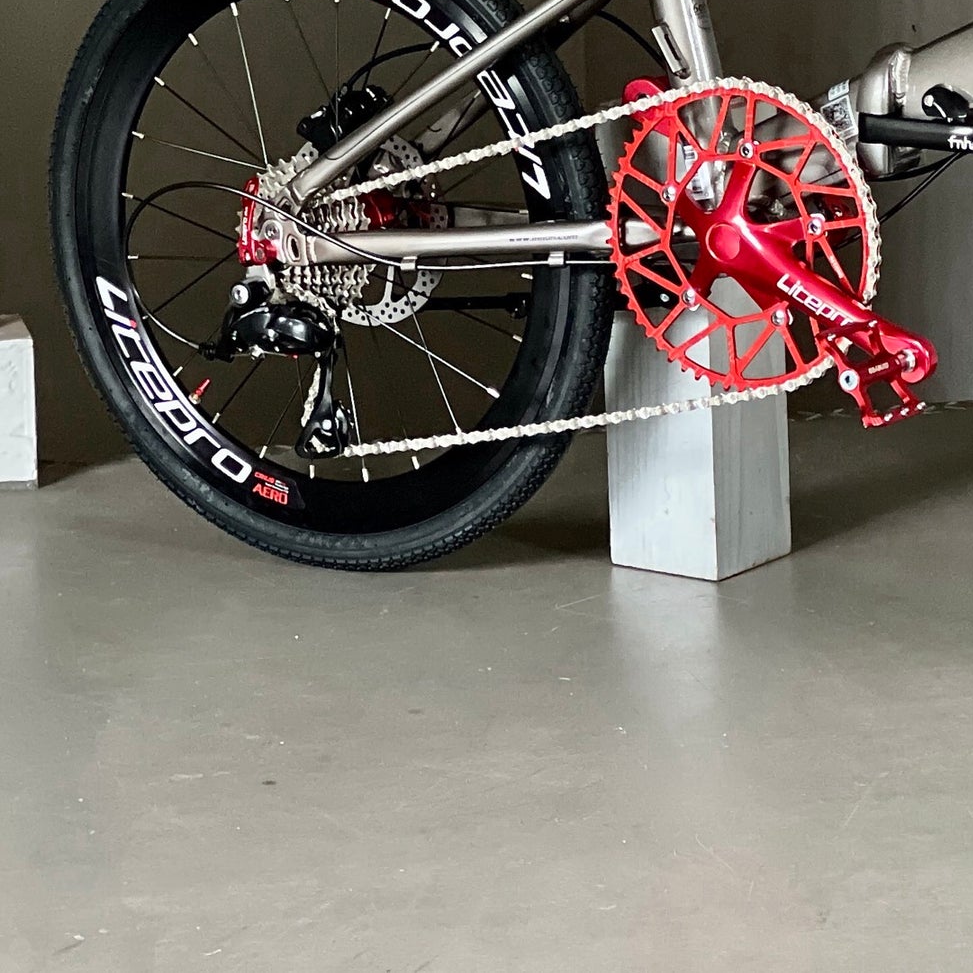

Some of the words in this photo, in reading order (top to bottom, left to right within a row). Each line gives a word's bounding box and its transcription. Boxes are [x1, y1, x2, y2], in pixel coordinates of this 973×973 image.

[776, 273, 854, 327] Litepr
[95, 276, 253, 484] Litepro
[252, 483, 288, 505] AERO
